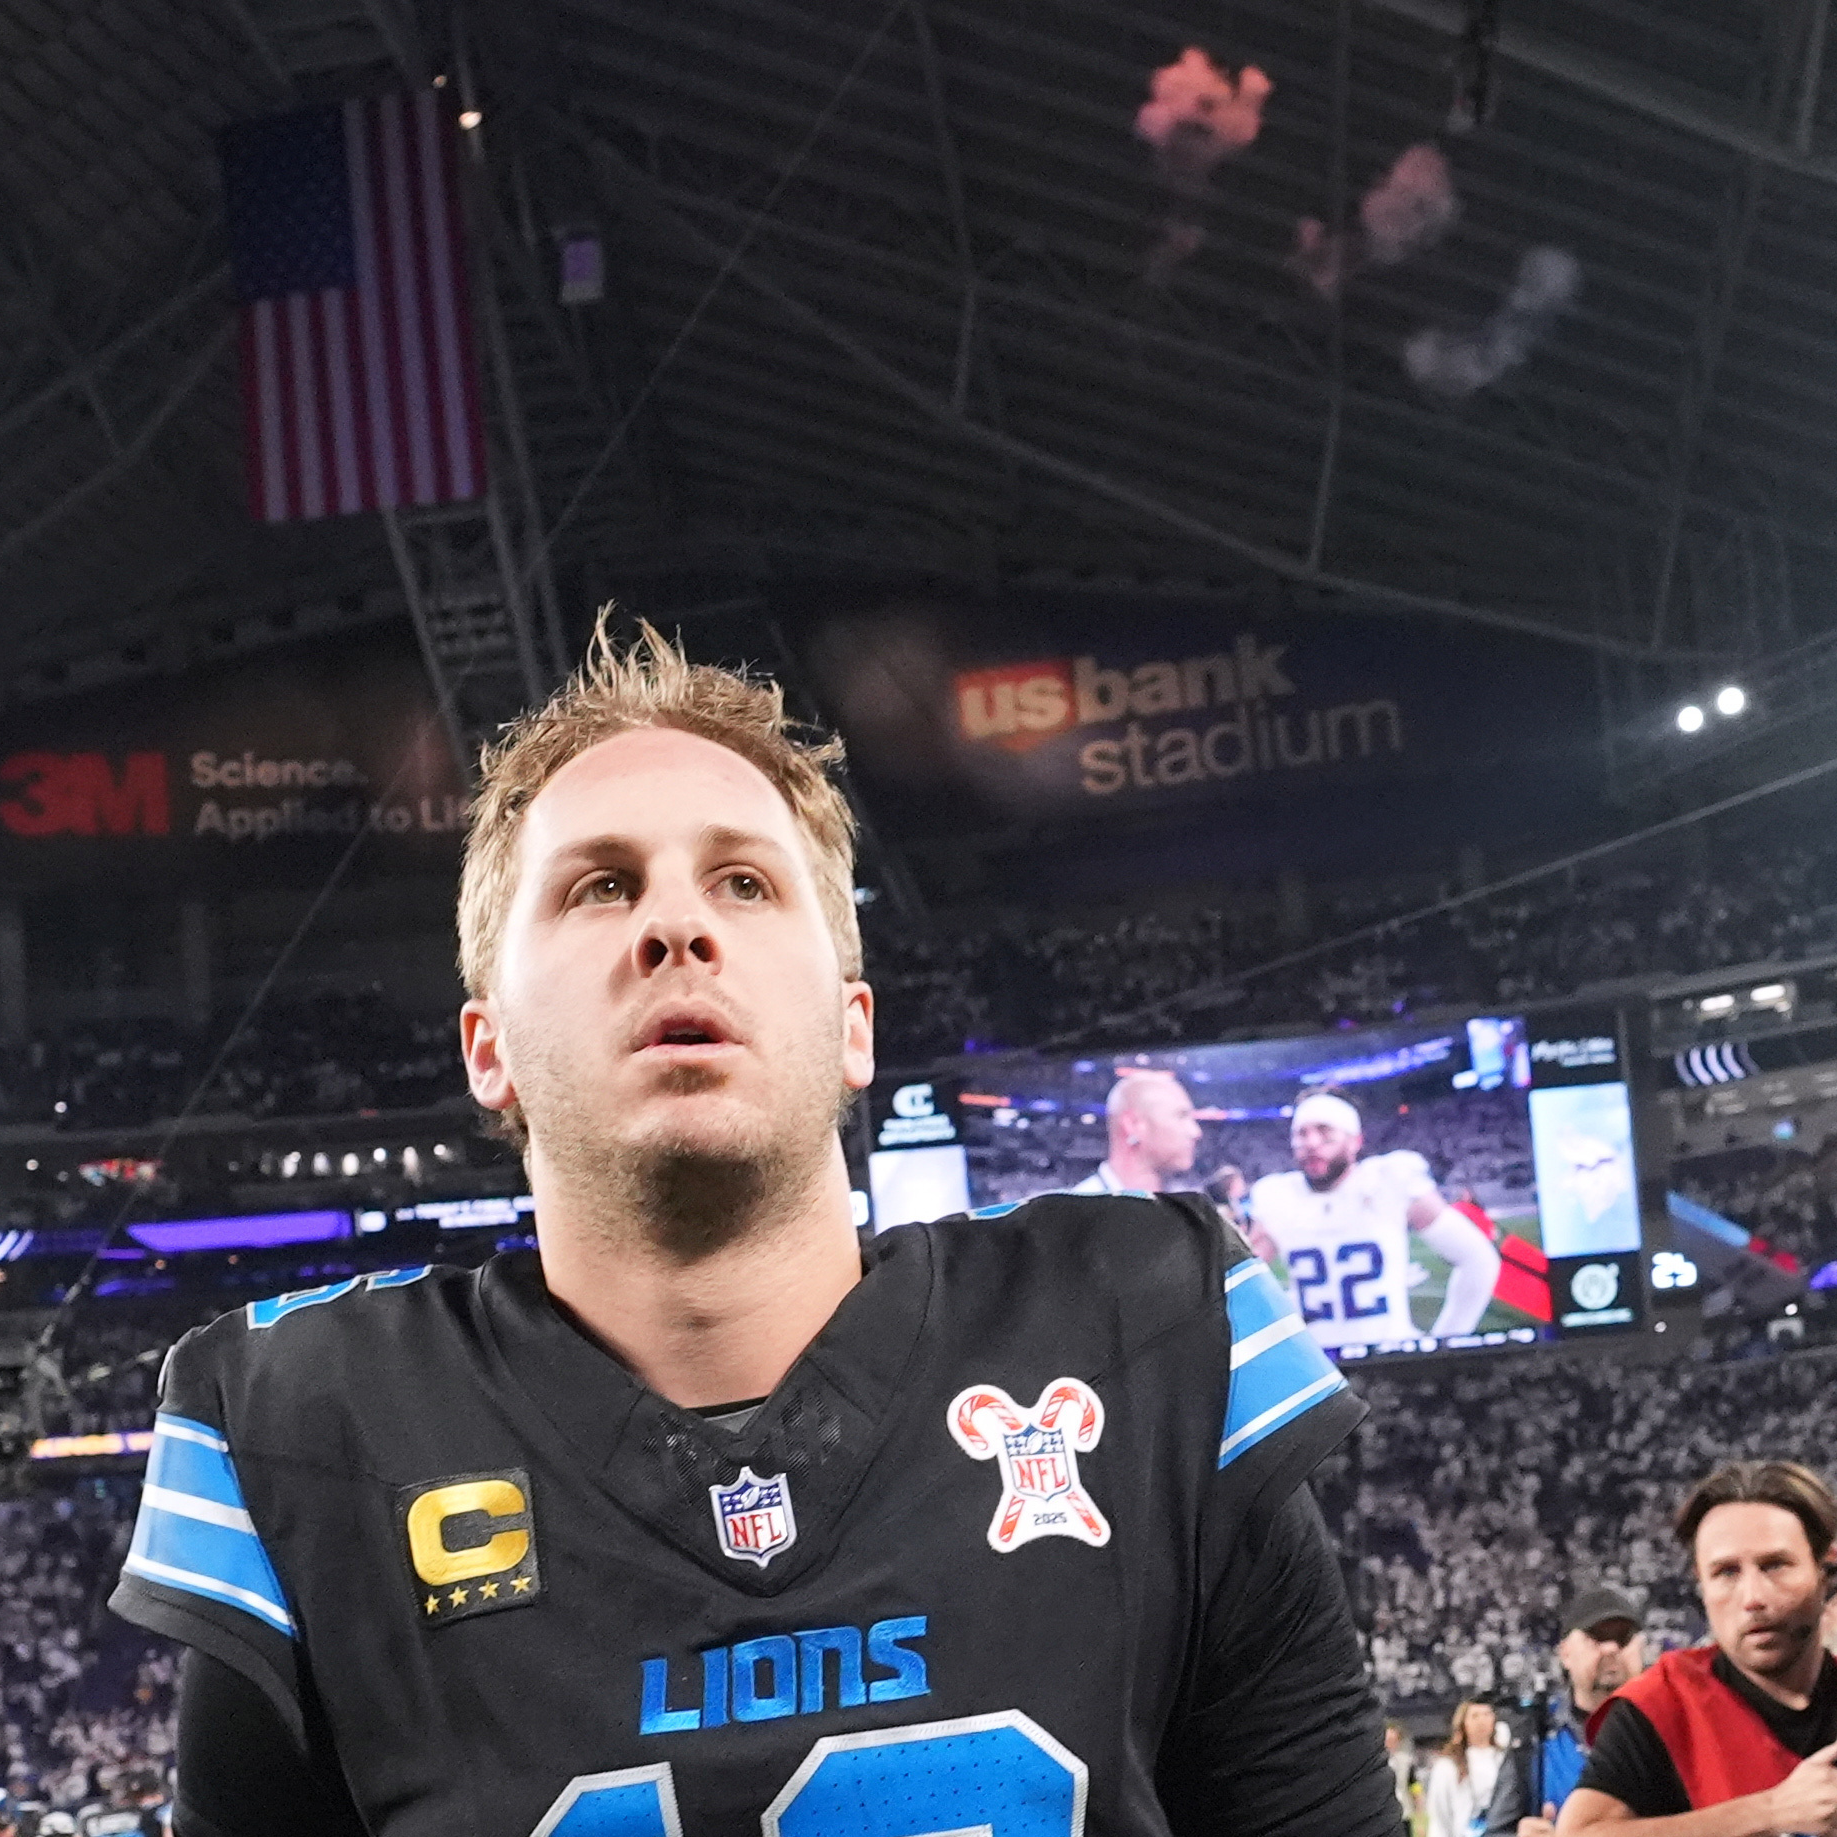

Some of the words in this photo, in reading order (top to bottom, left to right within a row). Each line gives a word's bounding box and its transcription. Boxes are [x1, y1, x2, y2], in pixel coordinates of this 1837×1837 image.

[1077, 706, 1403, 794] stadium
[194, 798, 362, 841] Applied
[370, 804, 411, 832] to
[1288, 1242, 1389, 1324] 22
[1014, 1456, 1067, 1494] NFL
[729, 1511, 783, 1550] NFL
[1032, 1510, 1068, 1527] 2025
[638, 1613, 932, 1736] LIONS
